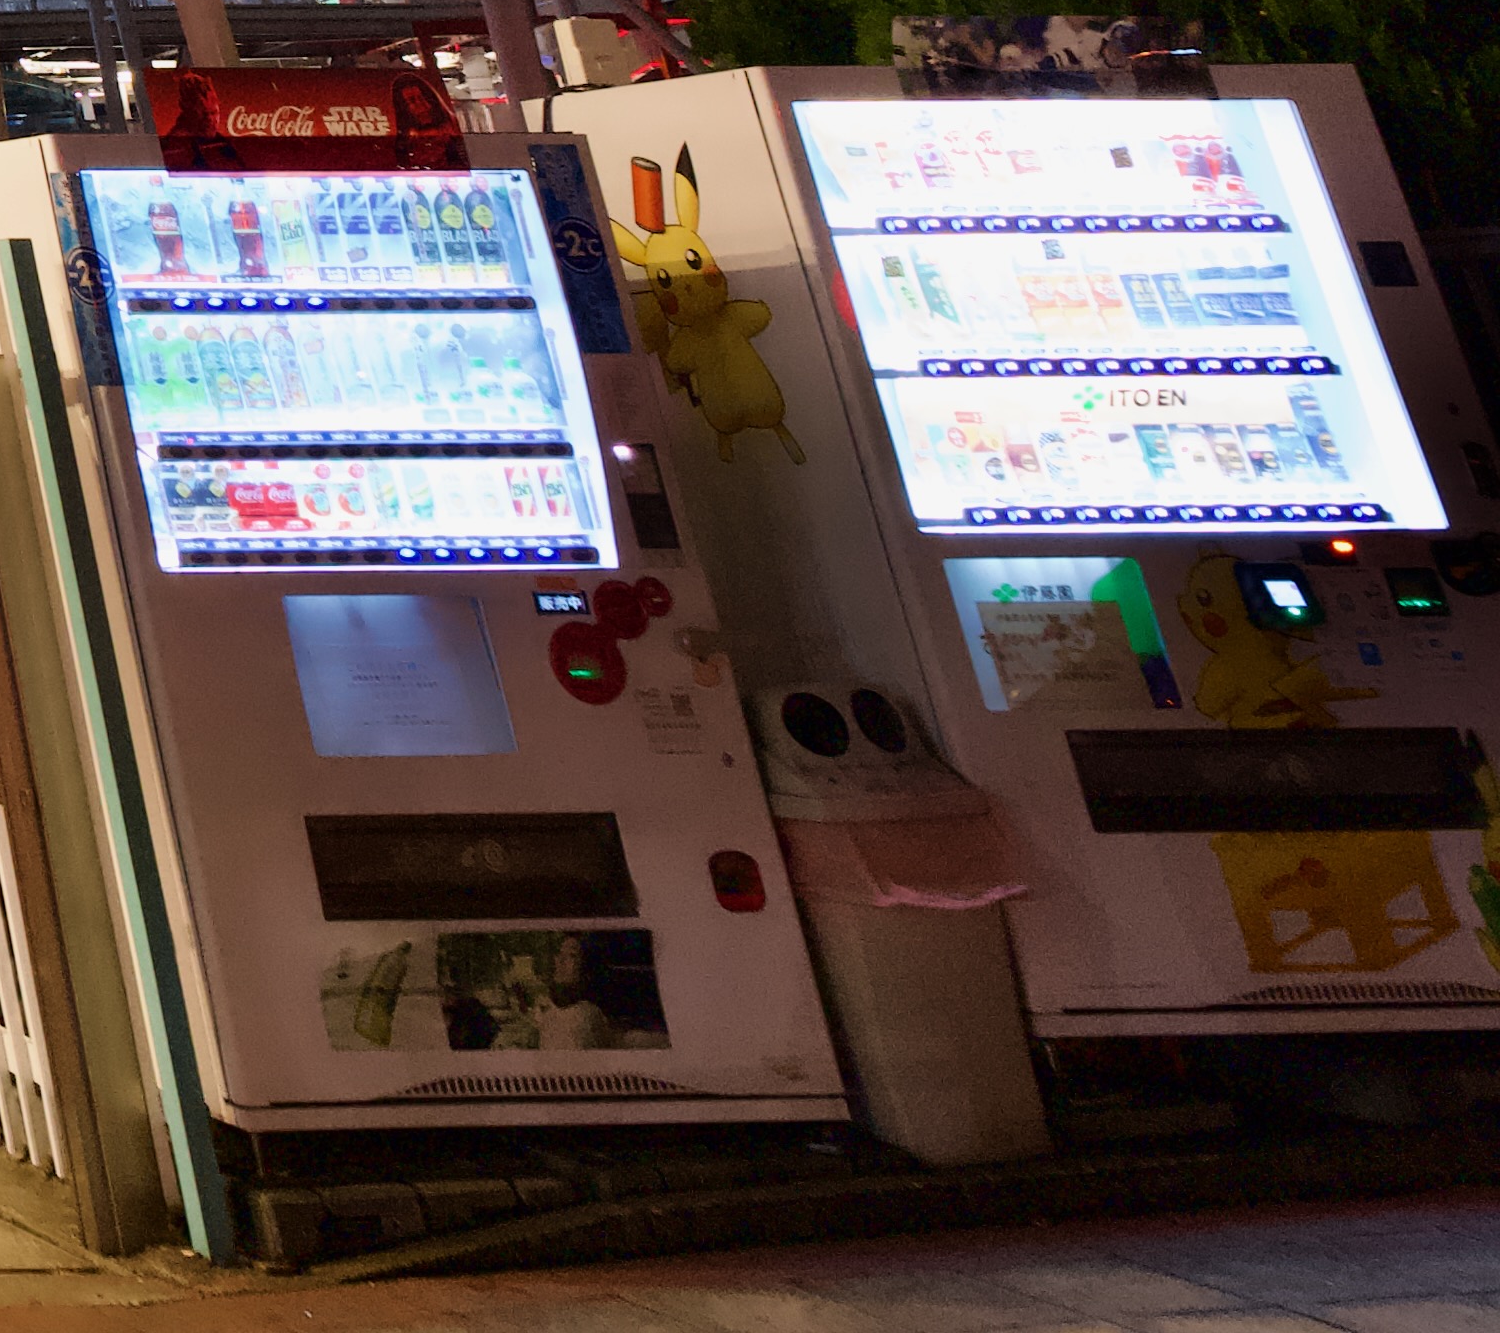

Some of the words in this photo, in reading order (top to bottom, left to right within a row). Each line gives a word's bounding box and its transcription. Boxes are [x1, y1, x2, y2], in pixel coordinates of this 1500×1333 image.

[226, 105, 315, 137] Coca-Cola
[322, 105, 388, 122] STAR
[323, 120, 391, 137] WARS
[1109, 388, 1151, 407] ITO
[1157, 388, 1187, 407] EN
